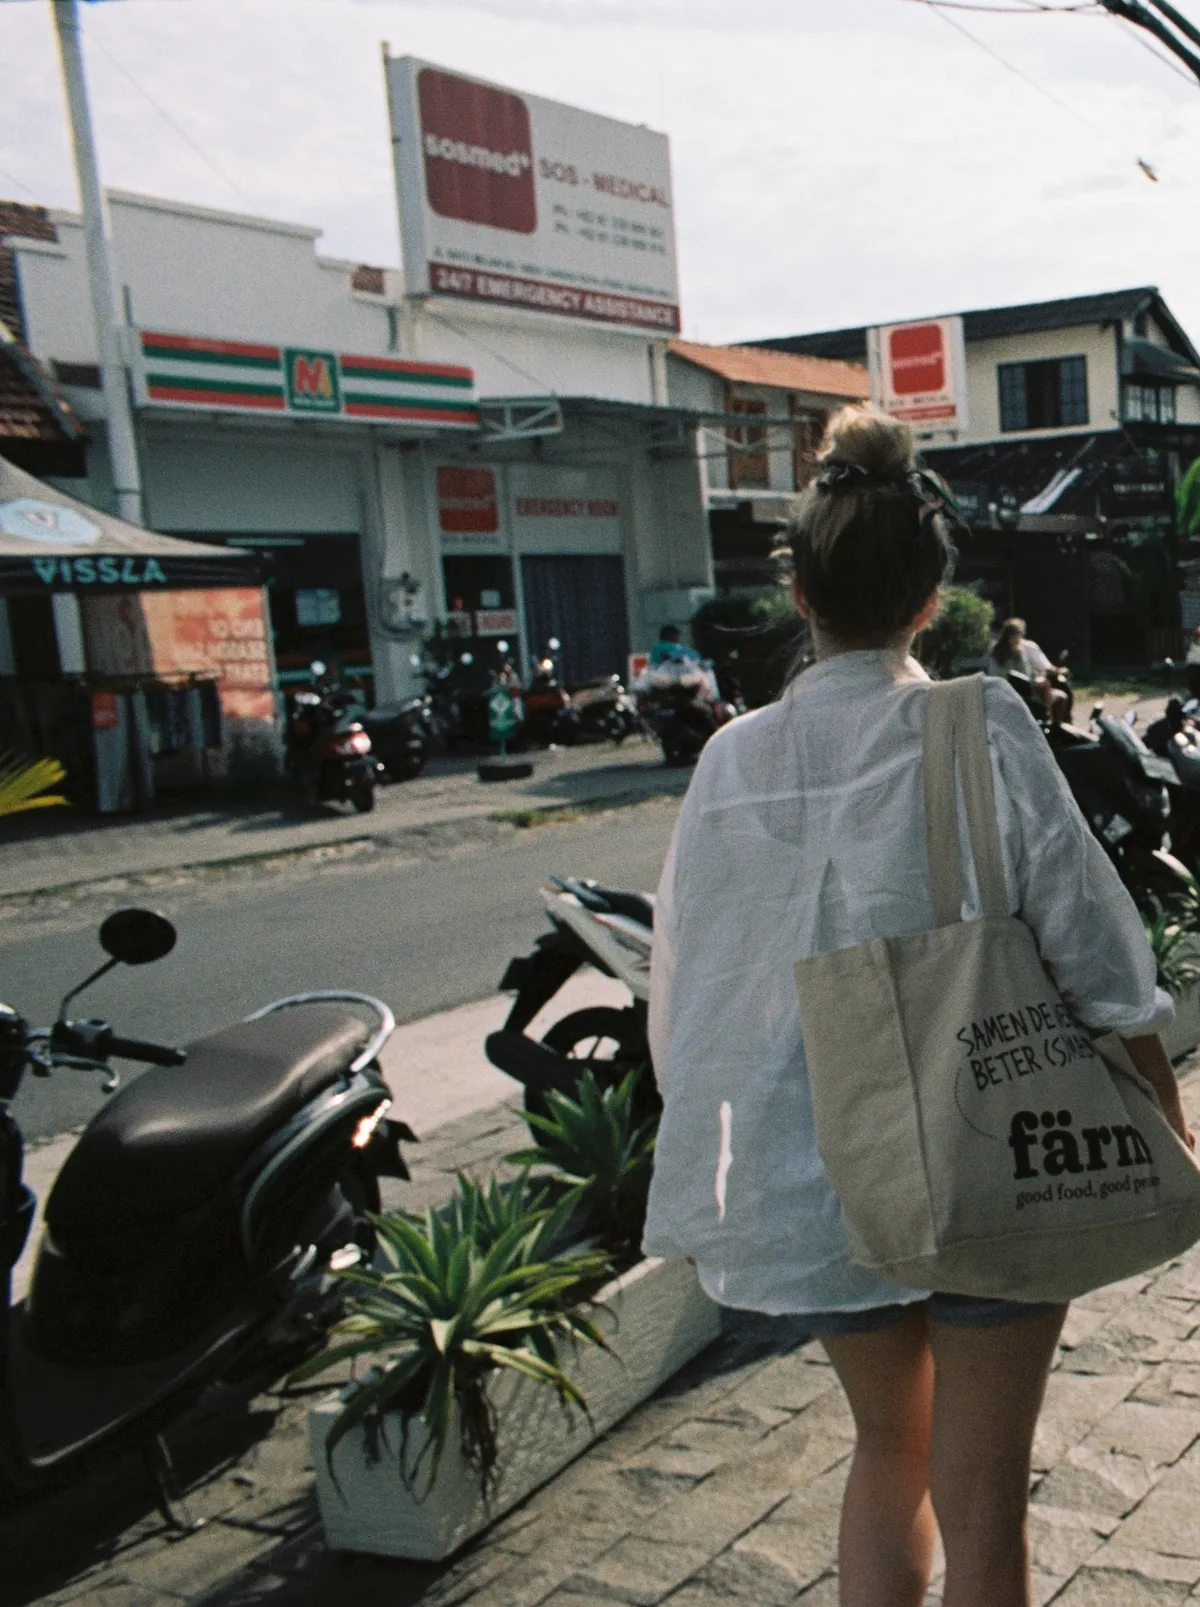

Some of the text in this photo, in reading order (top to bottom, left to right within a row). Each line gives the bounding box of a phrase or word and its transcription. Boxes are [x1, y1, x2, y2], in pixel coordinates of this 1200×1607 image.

[592, 172, 671, 208] MEDICAL
[476, 274, 582, 310] EMERGENCY
[583, 293, 676, 325] ASSISTANCE
[32, 556, 168, 584] VISSLA
[957, 1010, 1029, 1057] SAMEN
[970, 1045, 1043, 1091] BETER
[1008, 1109, 1154, 1180] färm
[1016, 1184, 1053, 1211] good
[1056, 1180, 1098, 1201] food,
[1100, 1174, 1131, 1199] good
